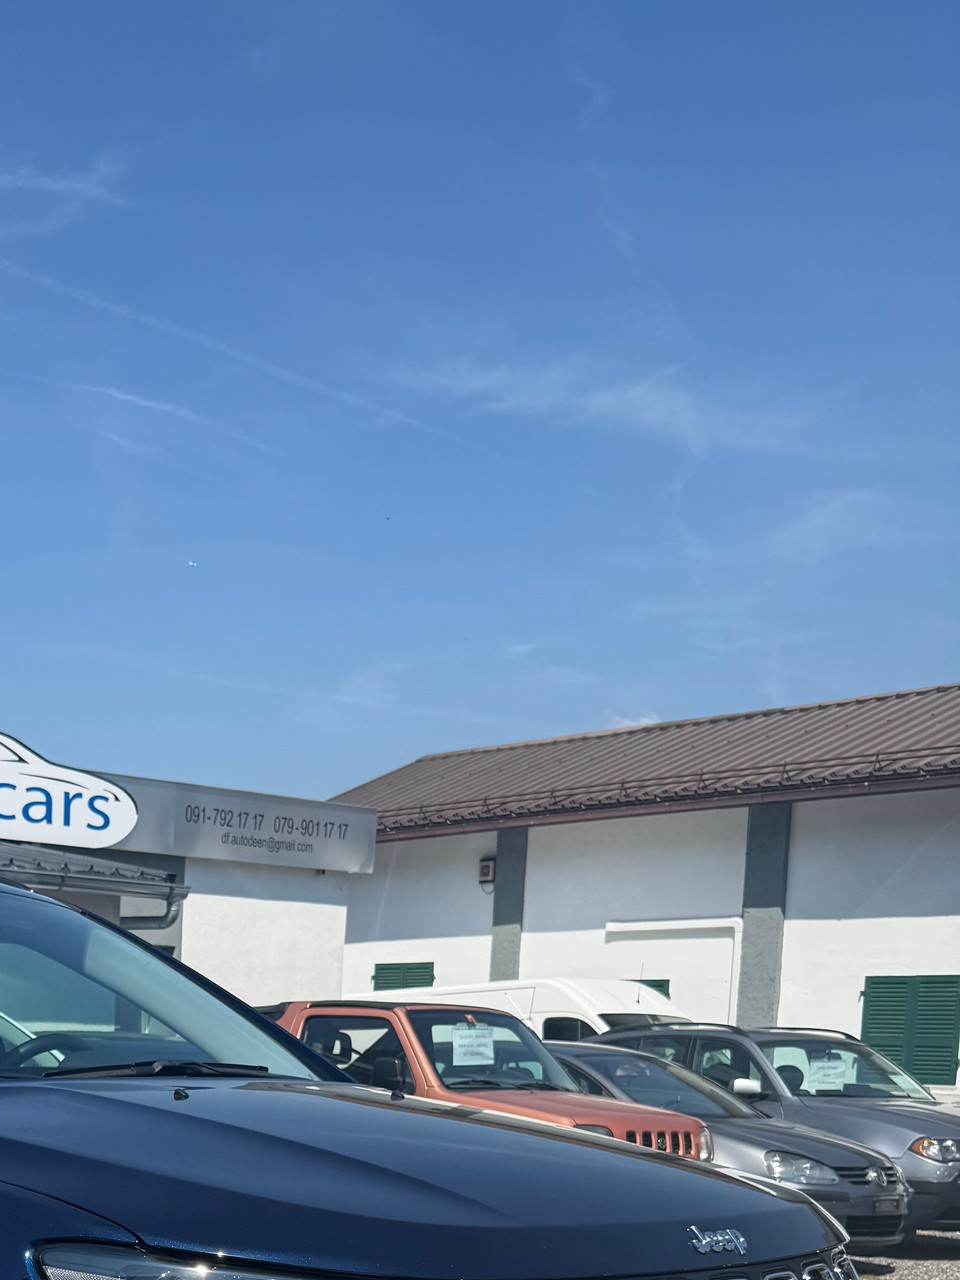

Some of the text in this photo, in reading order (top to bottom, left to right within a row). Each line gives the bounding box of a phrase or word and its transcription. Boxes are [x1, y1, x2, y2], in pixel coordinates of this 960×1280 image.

[185, 804, 234, 828] 091-792
[237, 812, 250, 829] 17
[253, 813, 265, 831] 17
[323, 821, 335, 839] 17
[337, 823, 349, 840] 17
[686, 1225, 748, 1255] Jeep
